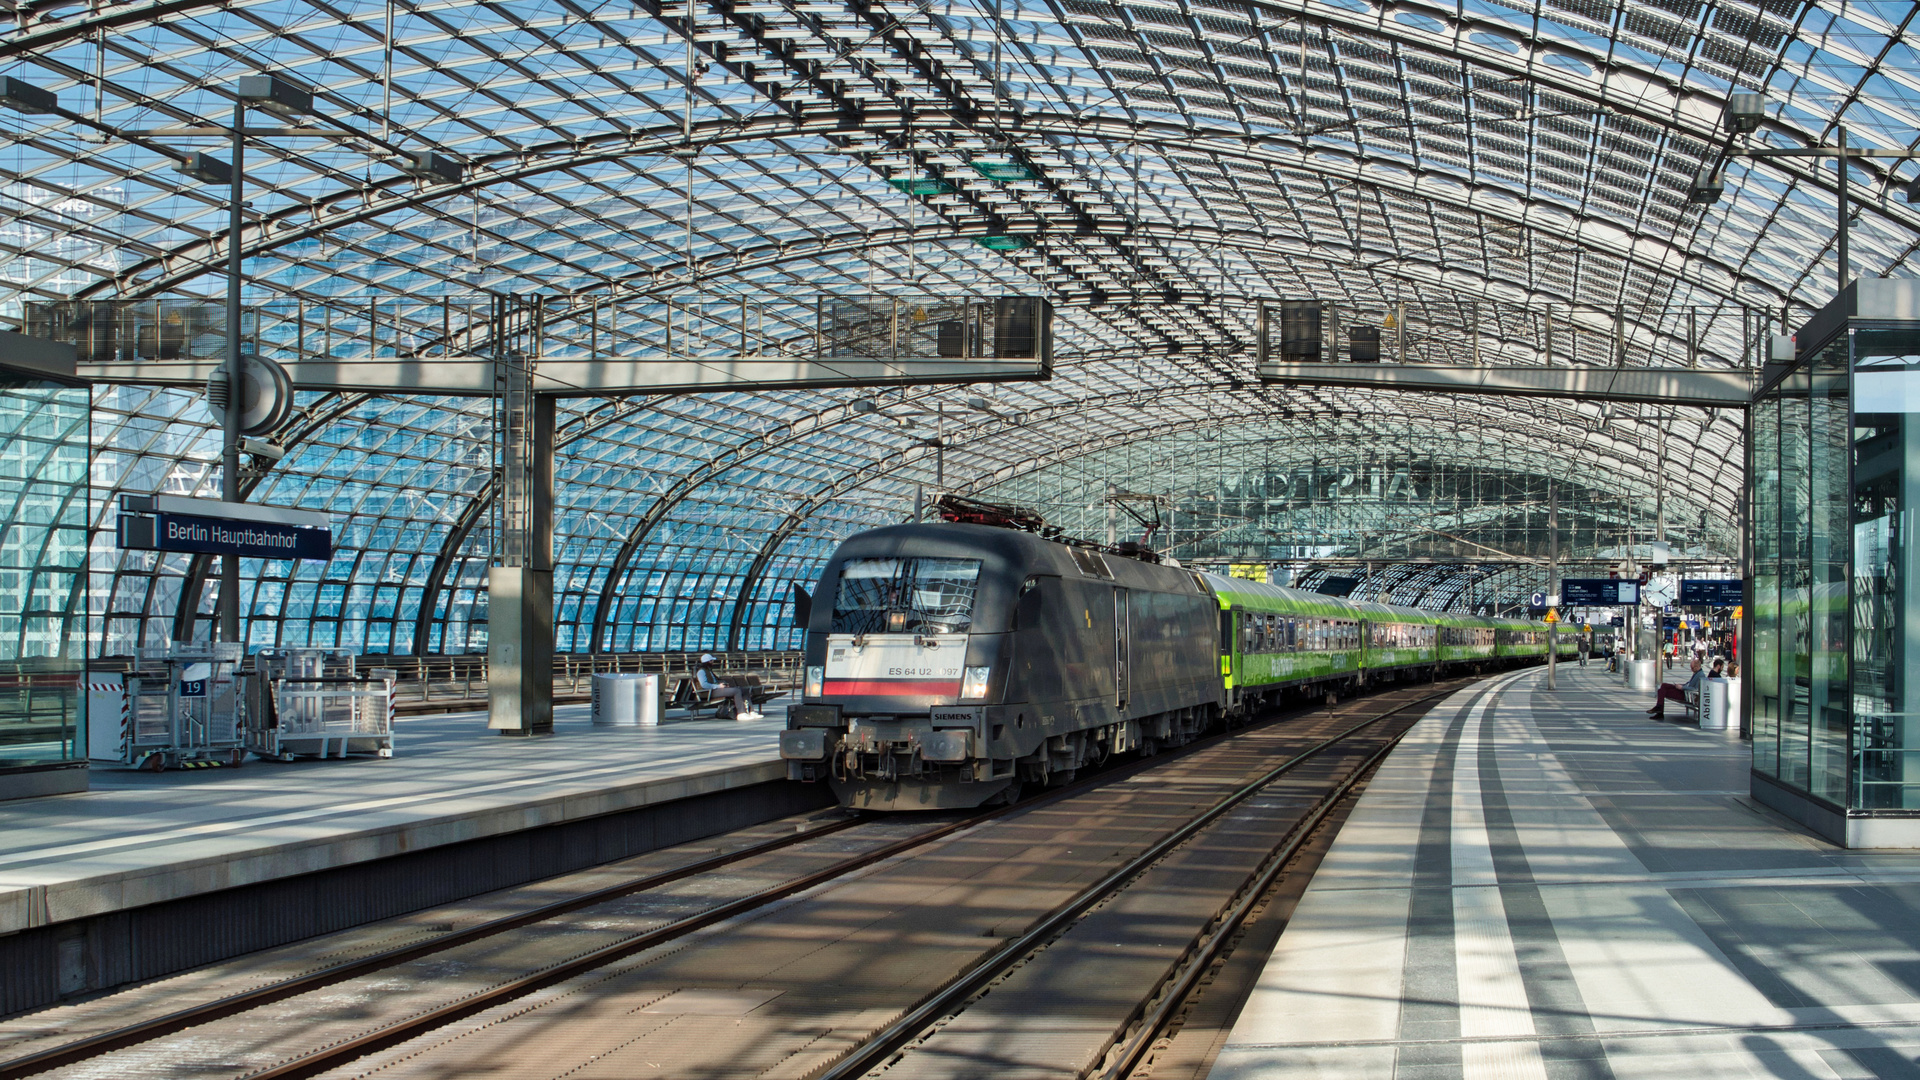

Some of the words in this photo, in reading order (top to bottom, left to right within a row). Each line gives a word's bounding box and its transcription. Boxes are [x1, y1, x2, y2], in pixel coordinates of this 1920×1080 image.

[168, 521, 208, 542] Berlin
[212, 525, 298, 549] Hauptbahnhof
[1531, 592, 1542, 606] C
[1576, 616, 1582, 624] D
[889, 667, 902, 676] ES
[904, 667, 916, 676] 64
[919, 667, 932, 676] U2
[187, 682, 201, 693] 19
[1703, 692, 1711, 720] Abfall
